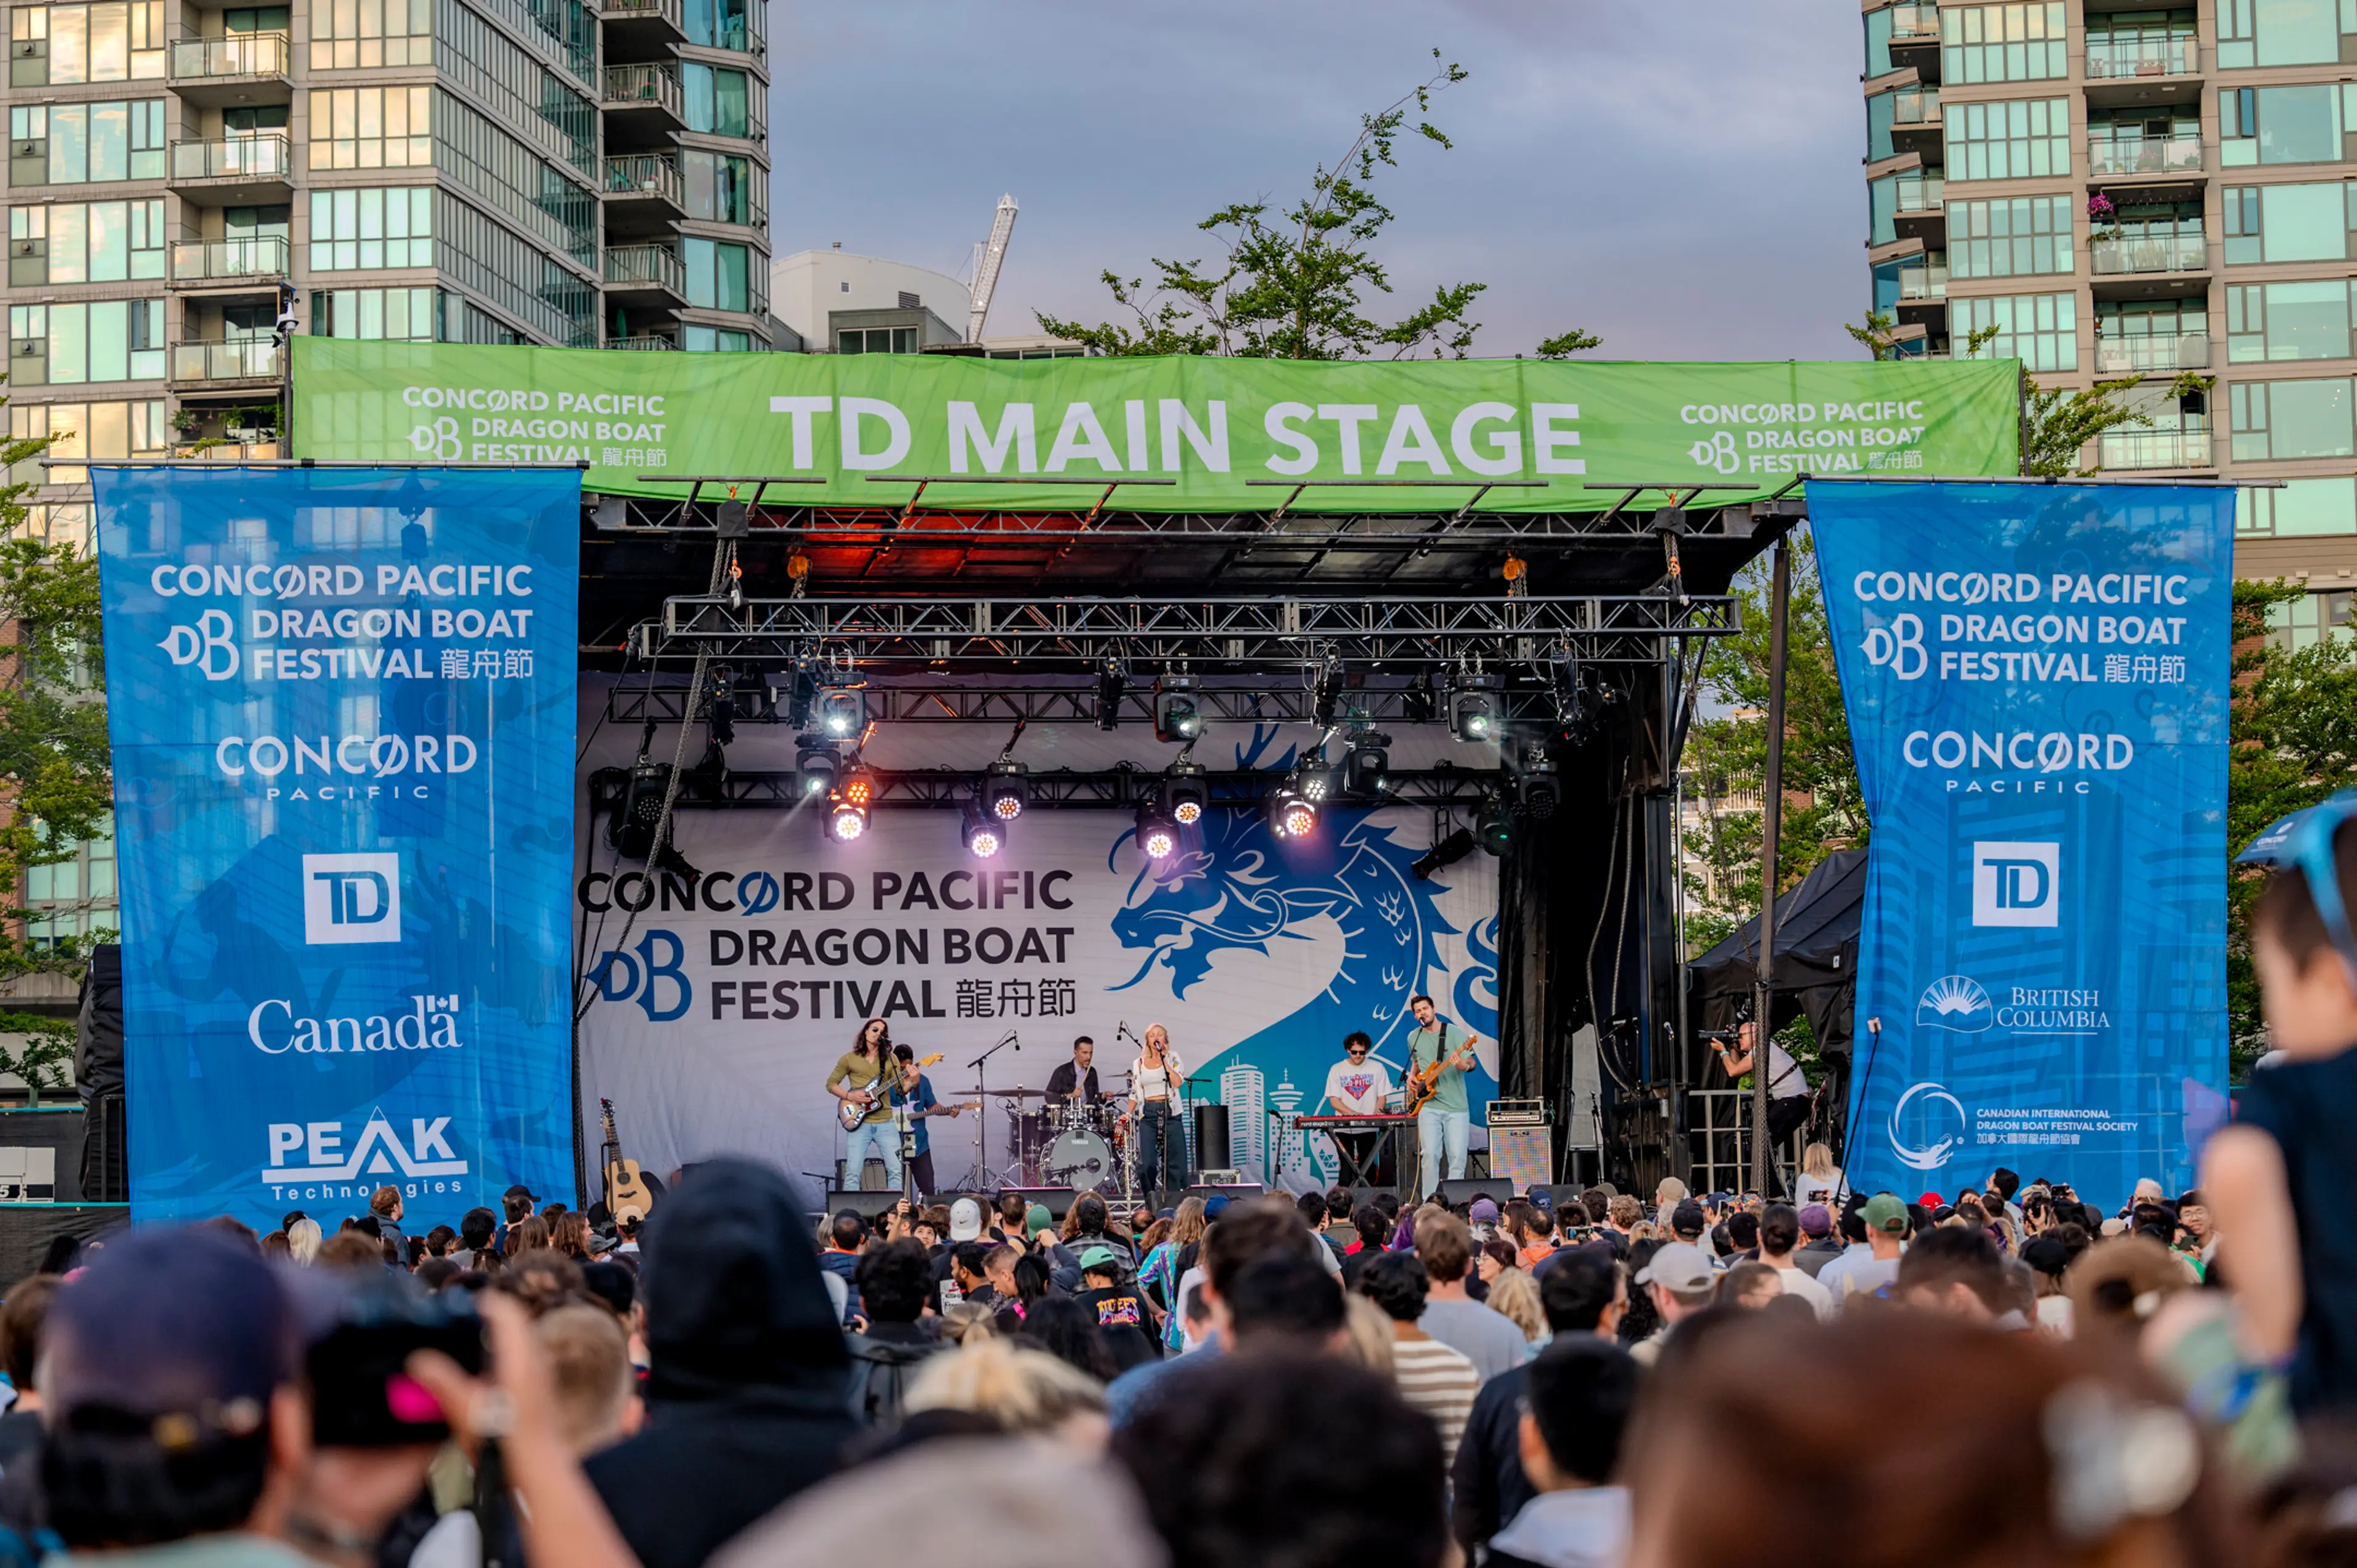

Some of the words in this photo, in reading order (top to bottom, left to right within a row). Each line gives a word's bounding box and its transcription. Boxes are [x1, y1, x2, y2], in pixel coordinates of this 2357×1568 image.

[558, 392, 665, 416] PACIFIC
[1824, 401, 1923, 422] PACIFIC
[472, 417, 589, 439] DRAGON
[595, 422, 666, 442] BOAT
[770, 396, 911, 471] TD
[947, 398, 1230, 473] MAIN
[1264, 401, 1586, 476] STAGE
[1746, 429, 1854, 449] DRAGON
[1861, 427, 1925, 446] BOAT
[472, 443, 597, 465] FESTIVAL
[602, 447, 667, 467] 龍舟節
[1749, 452, 1863, 473] FESTIVAL
[1867, 450, 1922, 469] 龍舟節
[377, 565, 532, 596] PACIFIC
[2052, 574, 2188, 604] PACIFIC
[252, 609, 420, 640] DRAGON
[432, 609, 533, 638] BOAT
[1941, 614, 2088, 643] DRAGON
[2098, 616, 2186, 644] BOAT
[253, 647, 433, 680] FESTIVAL
[441, 649, 533, 679] 龍舟節
[1941, 652, 2097, 682] FESTIVAL
[2105, 654, 2185, 683] 龍舟節
[267, 786, 427, 801] PACIFIC
[1946, 780, 2089, 794] PACIFIC
[313, 871, 390, 924] TD
[873, 870, 1074, 910] PACIFIC
[1982, 859, 2050, 909] TD
[710, 928, 929, 966] DRAGON
[943, 927, 1074, 964] BOAT
[711, 979, 946, 1020] FESTIVAL
[956, 978, 1075, 1018] 龍舟節
[2011, 987, 2099, 1007] BRITISH
[248, 994, 463, 1054] Canada
[1997, 1007, 2110, 1028] COLUMBIA
[1977, 1108, 2029, 1118] CANADIAN
[2032, 1109, 2110, 1119] INTERNATIONAL
[1977, 1121, 2019, 1130] DRAGON
[2022, 1121, 2048, 1130] BOAT
[2051, 1121, 2094, 1131] FESTIVAL
[2097, 1122, 2137, 1131] SOCIETY
[268, 1106, 457, 1168] PEAK
[271, 1181, 462, 1200] Technolgies
